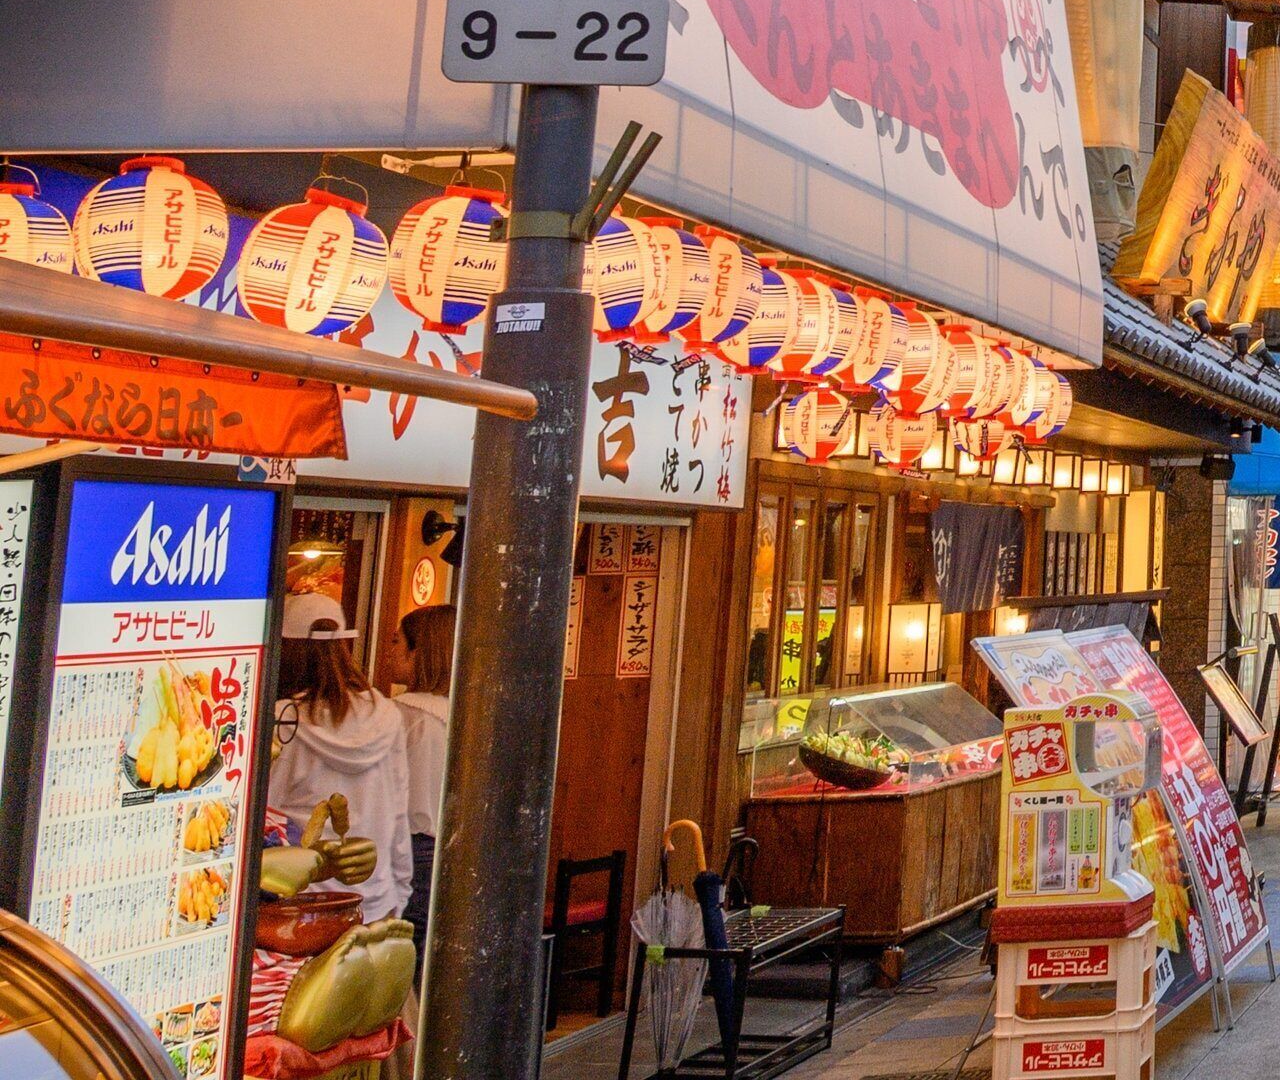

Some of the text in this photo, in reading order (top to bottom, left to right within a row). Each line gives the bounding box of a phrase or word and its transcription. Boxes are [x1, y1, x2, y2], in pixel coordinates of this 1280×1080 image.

[92, 219, 134, 237] Asahi
[156, 187, 185, 270] アサヒビール
[250, 255, 289, 273] Asahi
[294, 230, 341, 313] アサヒビール
[416, 216, 449, 297] アサヒビール
[453, 255, 499, 273] Asahi
[600, 258, 637, 277] Asahi
[707, 252, 734, 318] アサヒビール
[863, 310, 884, 366] アサヒビール
[5, 369, 243, 447] ふぐなら日本一
[688, 359, 713, 495] 串かつ
[111, 500, 232, 588] Asahi
[112, 610, 216, 644] アサヒビール
[626, 580, 652, 659] シーザーサラダ
[200, 657, 246, 800] 串かつ
[1064, 703, 1120, 719] ガチャ串
[1009, 725, 1063, 752] ガチャ
[1013, 751, 1039, 779] 串
[1028, 959, 1108, 977] アサヒビール
[1025, 1052, 1103, 1069] アサヒビール
